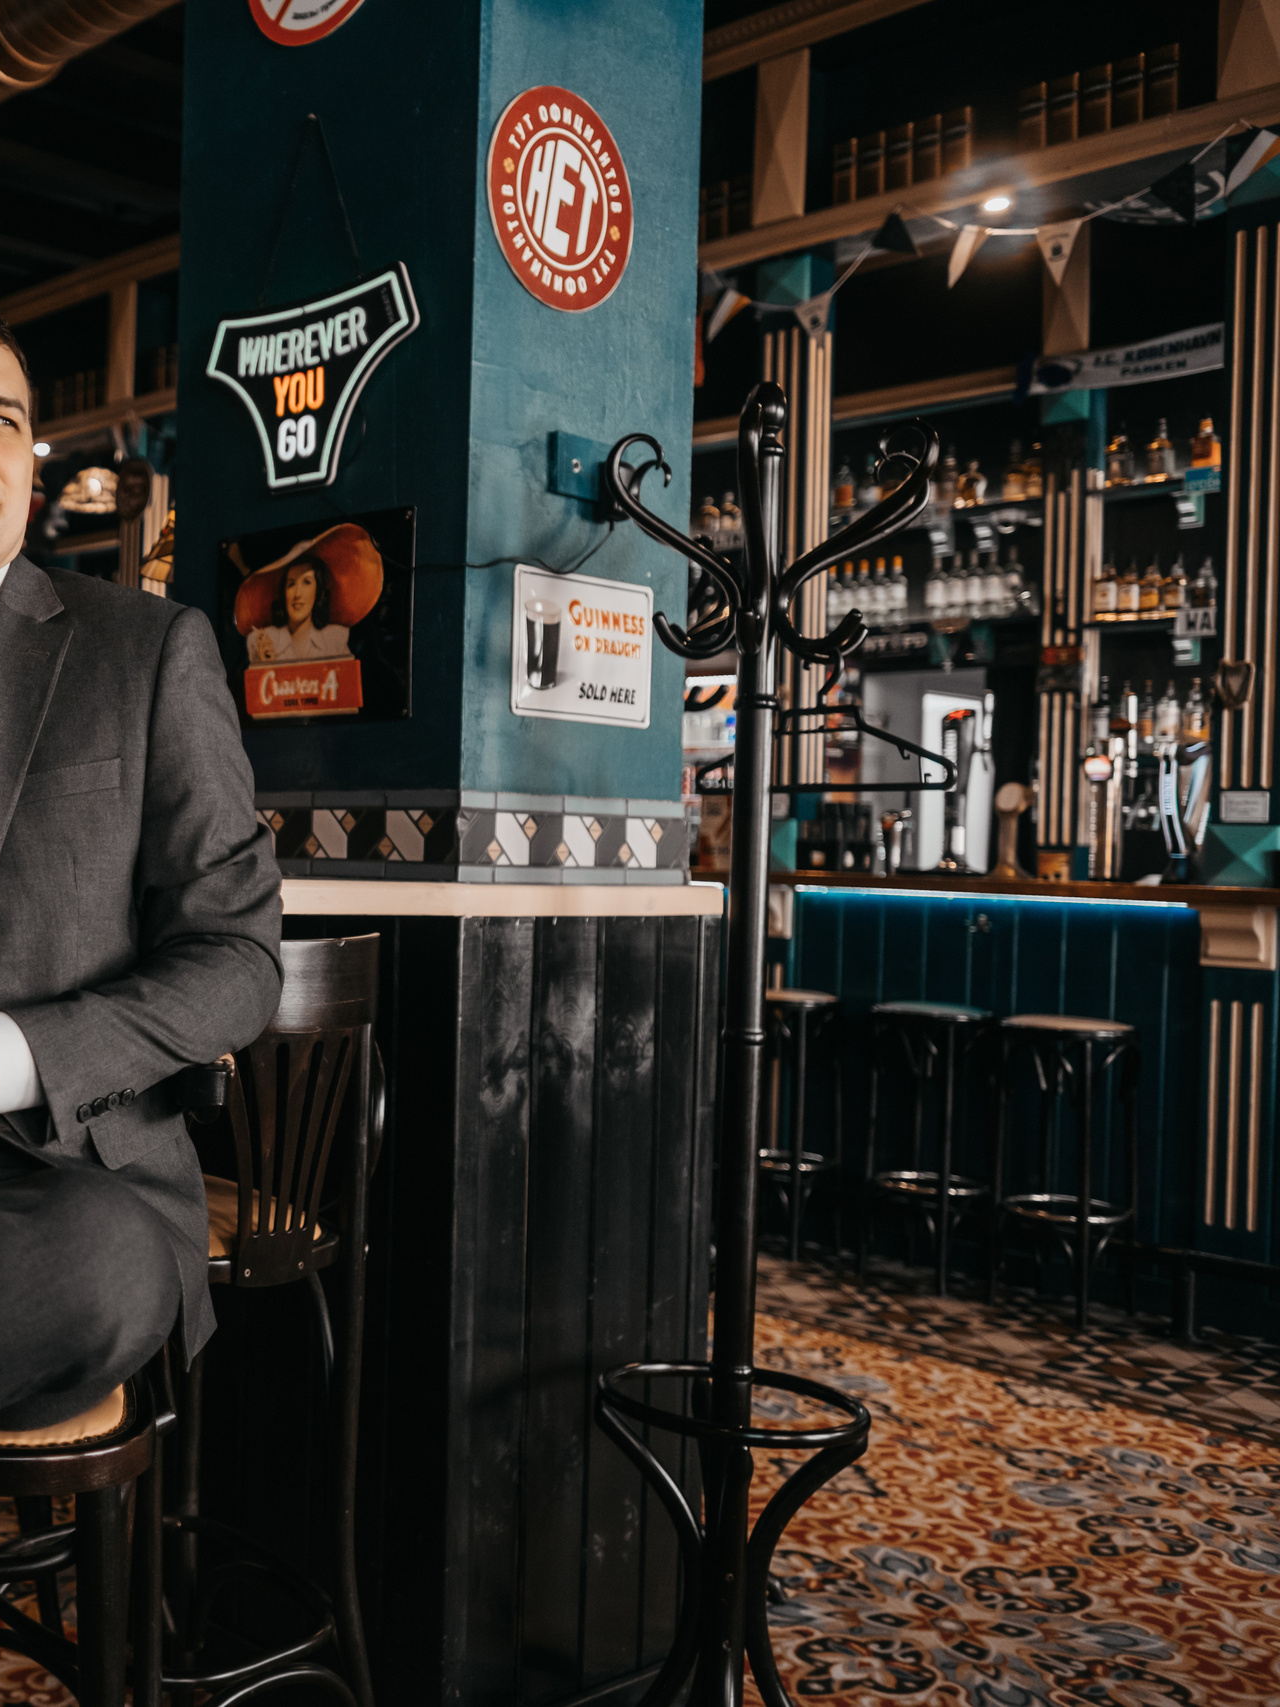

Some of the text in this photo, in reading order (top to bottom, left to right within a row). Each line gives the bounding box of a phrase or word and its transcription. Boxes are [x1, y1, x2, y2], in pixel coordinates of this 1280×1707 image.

[508, 103, 622, 213] ТУТ ОФИЦИАНТОВ
[526, 139, 599, 257] НЕТ
[501, 184, 616, 296] ТУТ ОФИЦИАНТОВ
[238, 306, 369, 377] WHEREVER
[273, 366, 325, 417] YOU
[277, 414, 317, 462] GO
[568, 598, 645, 637] GUINNESS
[575, 634, 641, 660] ON DRAUGHT
[261, 669, 319, 705] Craven
[579, 682, 637, 705] SOLD HERE
